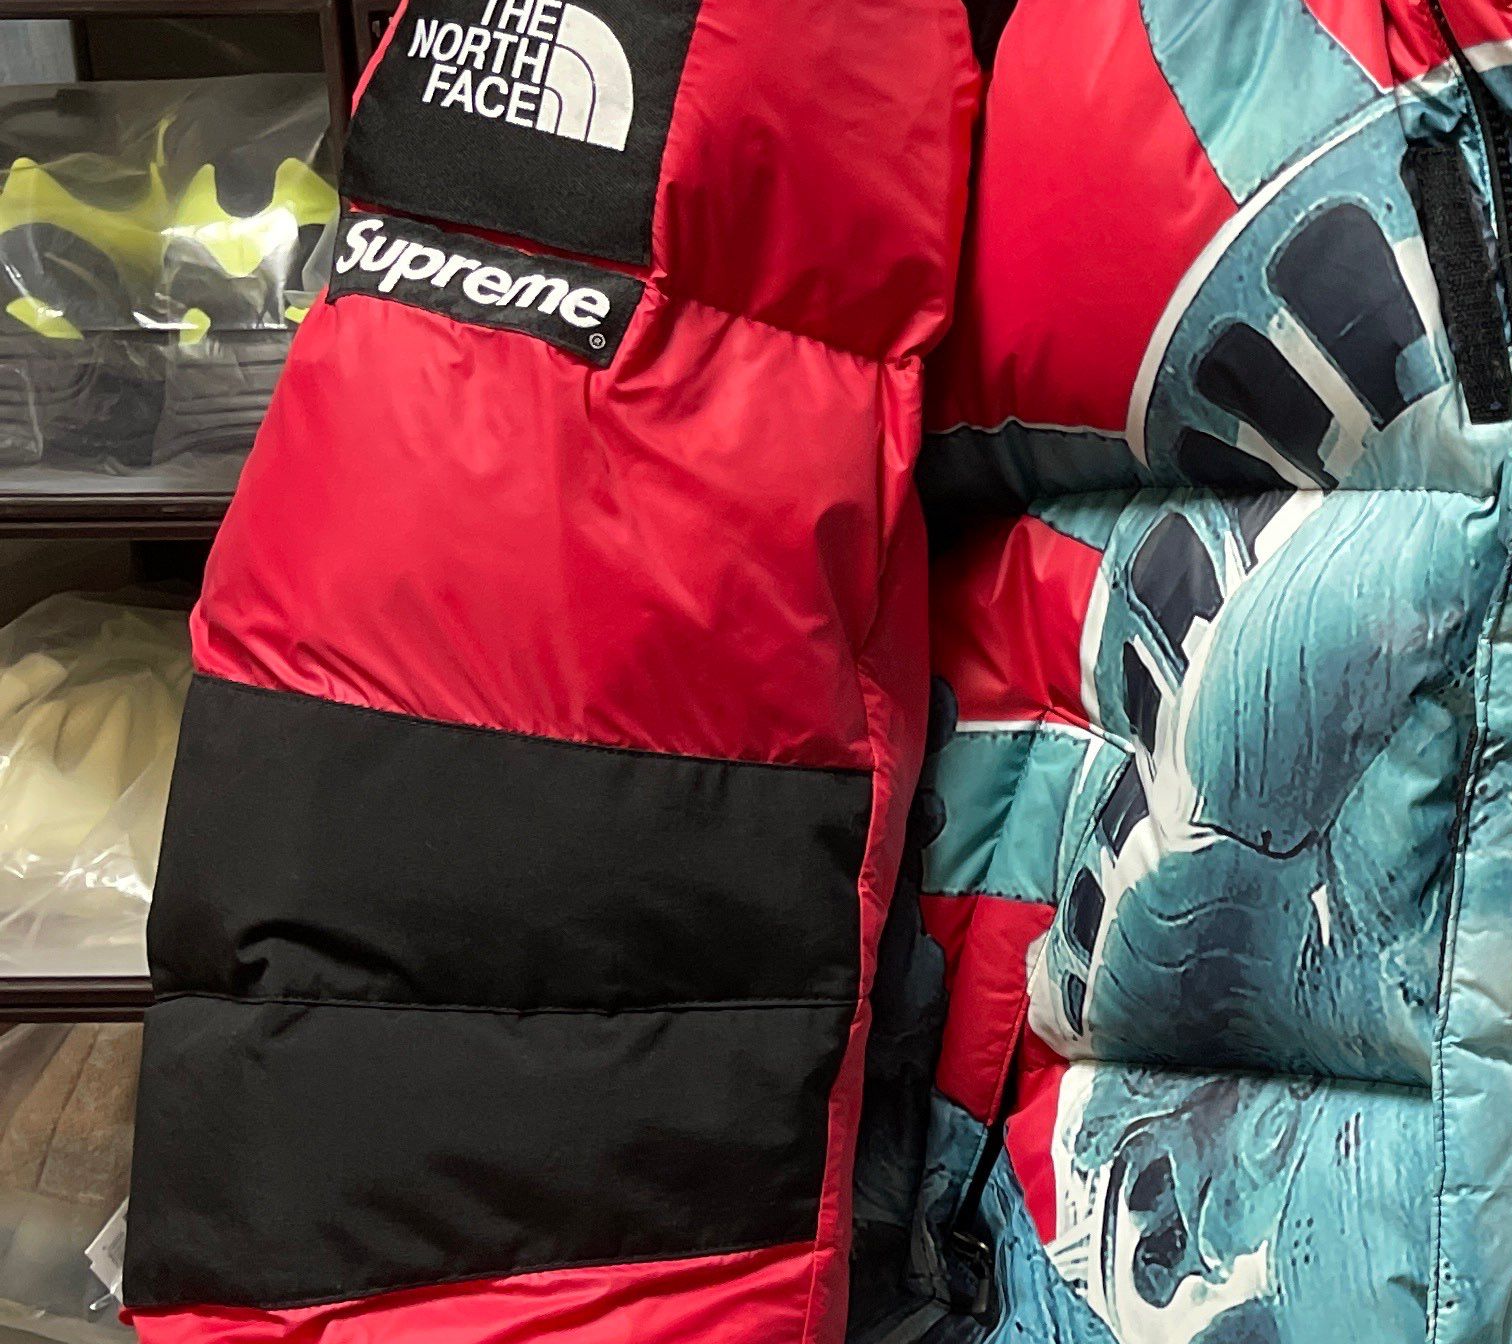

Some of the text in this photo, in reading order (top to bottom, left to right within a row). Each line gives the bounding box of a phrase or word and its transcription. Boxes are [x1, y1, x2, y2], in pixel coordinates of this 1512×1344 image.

[407, 18, 549, 84] NORTH
[422, 63, 540, 128] FACE
[336, 219, 610, 328] Supreme
